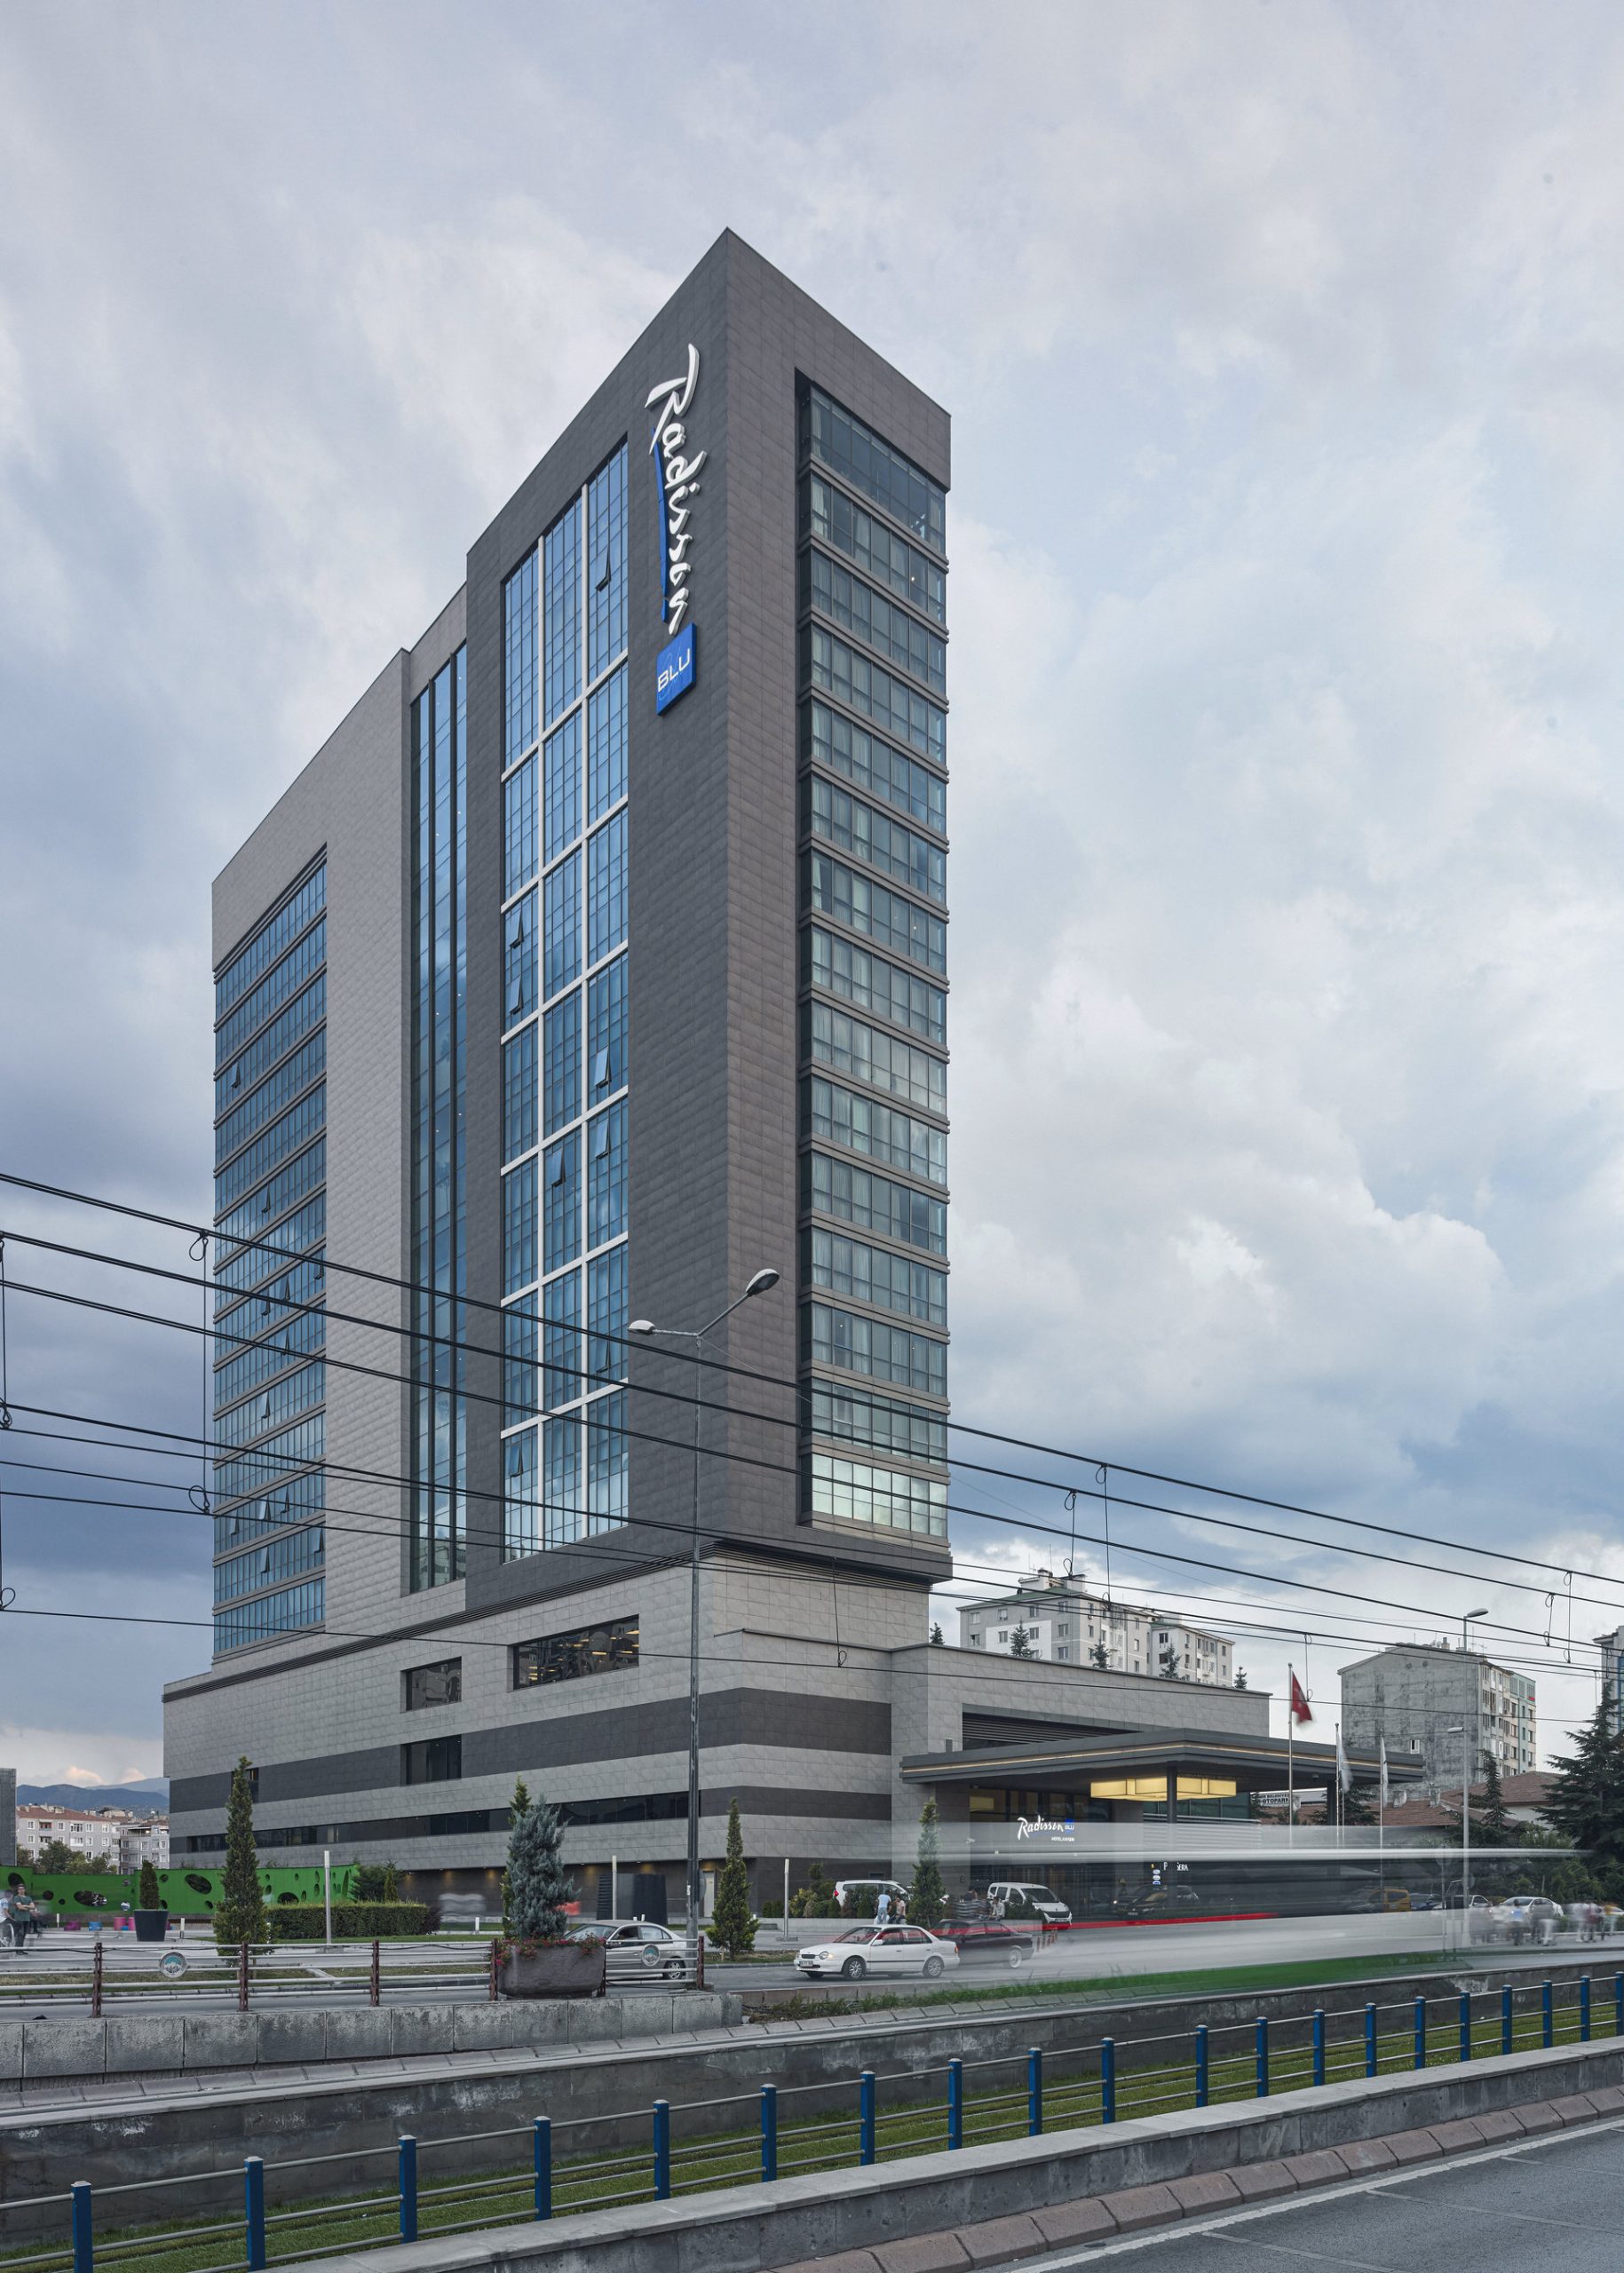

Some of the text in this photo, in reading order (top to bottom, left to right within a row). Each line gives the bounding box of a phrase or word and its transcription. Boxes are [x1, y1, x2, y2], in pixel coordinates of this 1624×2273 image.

[645, 343, 708, 637] Radisson
[657, 647, 691, 693] BLU
[1017, 1814, 1064, 1841] Radisson
